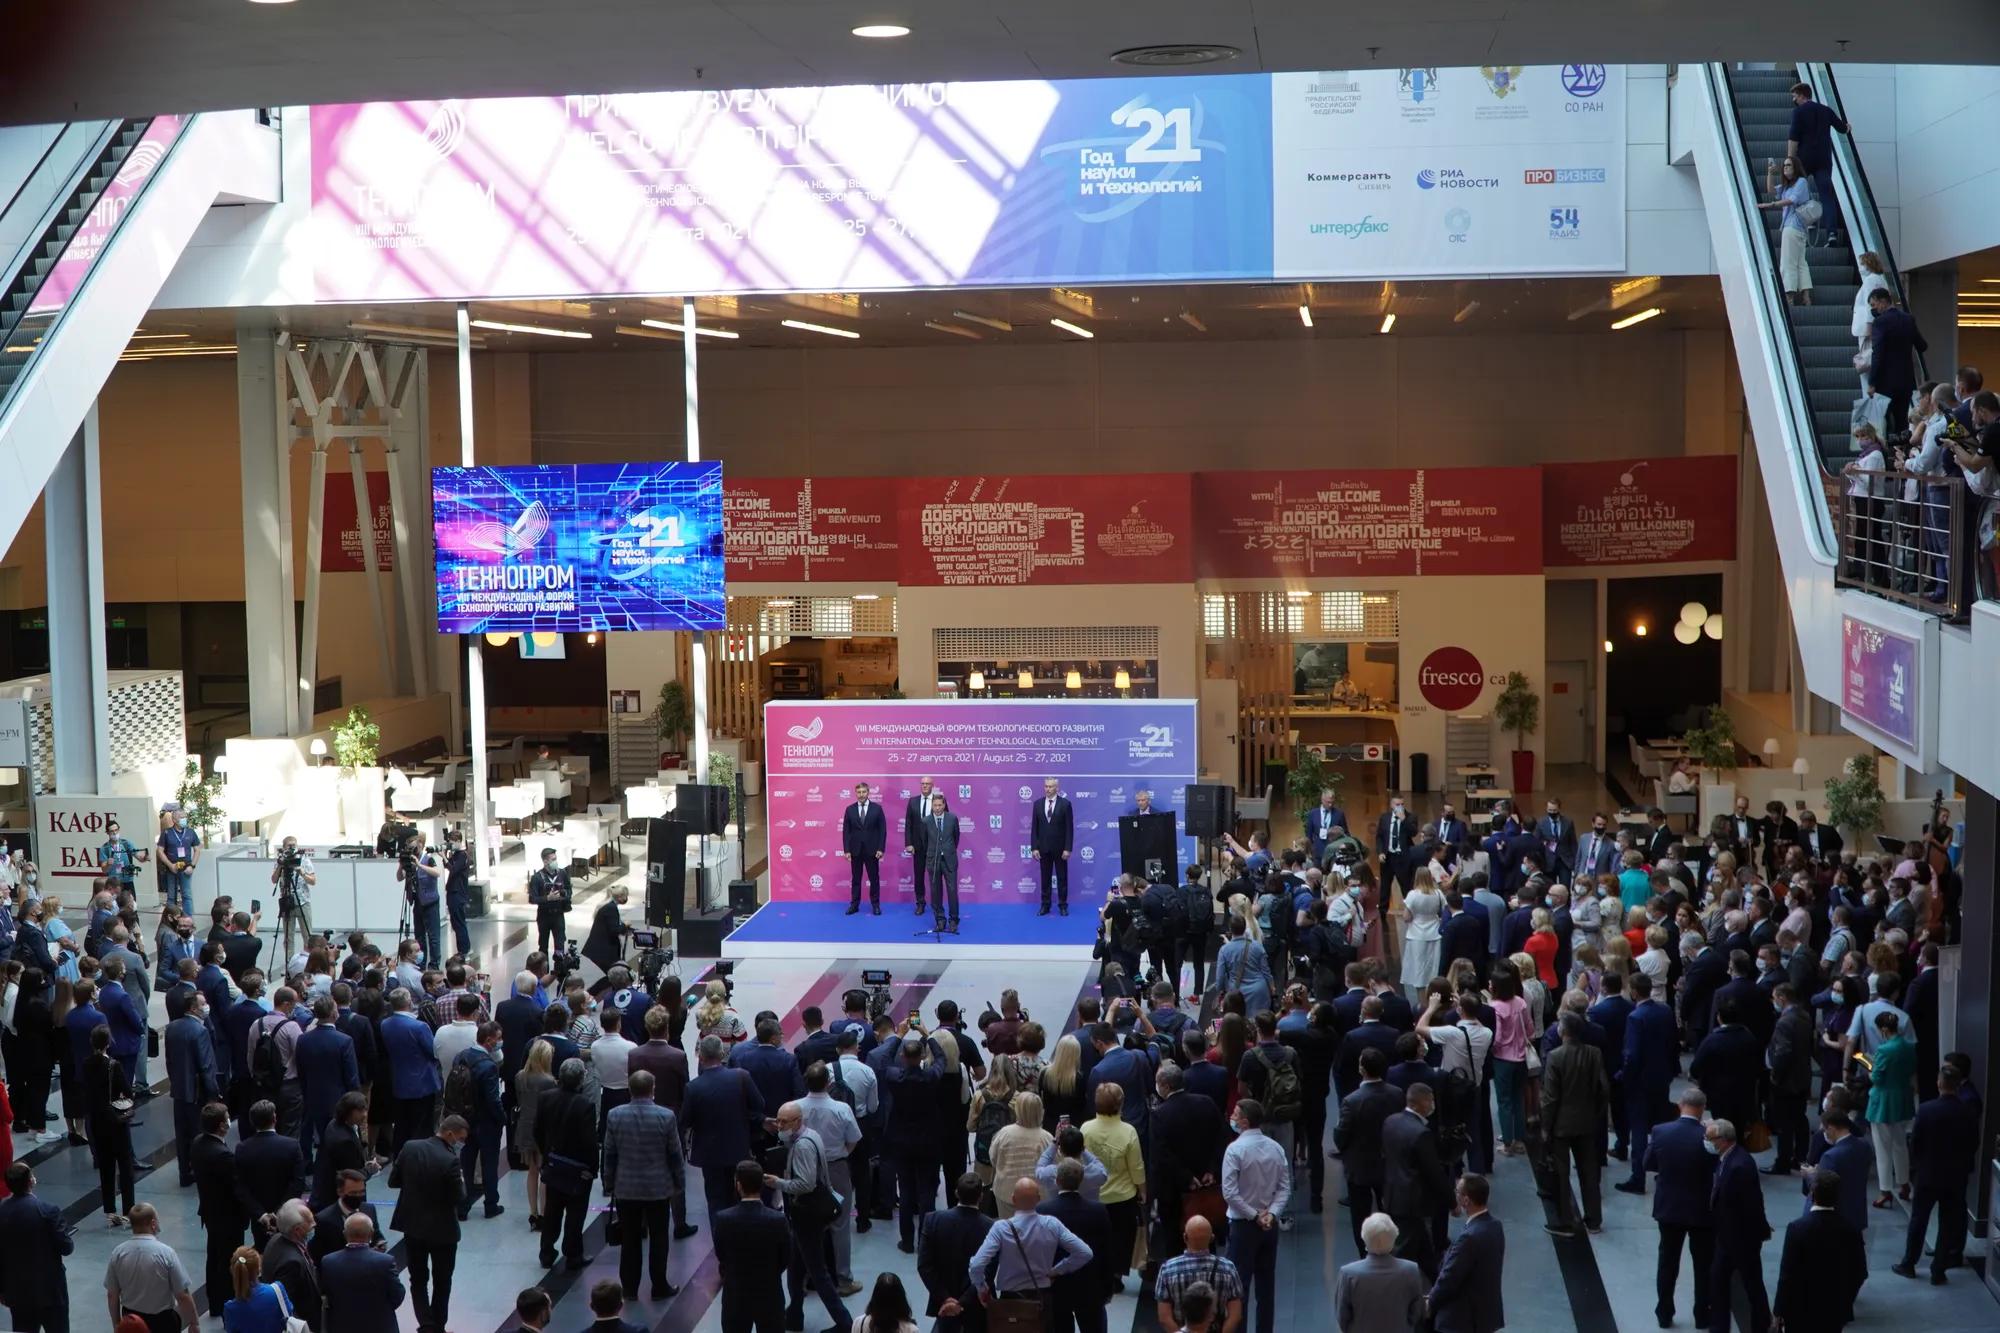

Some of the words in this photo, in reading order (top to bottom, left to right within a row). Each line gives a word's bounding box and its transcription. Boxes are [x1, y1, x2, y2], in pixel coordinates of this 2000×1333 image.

[1564, 102, 1580, 113] СО
[1582, 101, 1604, 112] РАН
[1080, 149, 1115, 166] Год
[1080, 166, 1136, 182] науки
[1307, 172, 1391, 182] Коммерсантъ
[1440, 169, 1464, 178] РИА
[1080, 183, 1093, 195] и
[1096, 176, 1202, 195] технологий
[1440, 178, 1499, 188] НОВОСТИ
[1550, 208, 1580, 229] 54
[1549, 229, 1580, 238] РАДИО
[1316, 490, 1381, 503] WELCOME
[723, 498, 771, 510] ELCOME
[972, 502, 1034, 513] BIENVENUE
[828, 515, 881, 524] BENVENUTO
[921, 509, 973, 522] ДОБРО
[973, 512, 1013, 520] WELCOME
[1282, 510, 1340, 525] ДОБРО
[921, 521, 1028, 535] ПОЖАЛОВАТЬ
[1311, 523, 1431, 540] ПОЖАЛОВАТЬ
[1561, 523, 1617, 534] HERZLICH
[1620, 519, 1695, 532] WILLKOMMEN
[341, 530, 391, 540] HERICH
[723, 530, 819, 545] ЖАЛОВАТЬ
[1071, 512, 1085, 557] WITAJ
[612, 538, 633, 550] Год
[1243, 534, 1305, 550] ようこそ
[1377, 538, 1442, 549] BIENVENUE
[612, 549, 646, 558] науки
[767, 545, 829, 556] BIENVENUE
[456, 564, 574, 590] ТЕХНОПРОМ
[456, 593, 470, 602] VIII
[471, 591, 544, 602] МЕЖДУНАРОДНЫЙ
[546, 591, 574, 601] ФОРУМ
[456, 602, 534, 613] ТЕХНОЛОГИЧЕСКОГО
[535, 602, 575, 612] РАЗВИТИЯ
[1421, 666, 1482, 686] fresco
[1489, 673, 1513, 686] ca
[854, 724, 867, 732] VIII
[868, 723, 945, 733] МЕЖДУНАРОДНЫЙ
[946, 724, 976, 733] ФОРУМ
[978, 724, 1060, 733] ТЕХНОЛОГИЧЕСКОГО
[1061, 724, 1105, 733] РАЗВИТИЯ
[860, 737, 873, 745] VIII
[874, 737, 934, 745] INTERNATIONAL
[935, 737, 963, 745] FORUM
[965, 737, 975, 745] OF
[977, 737, 1040, 746] TECHNOLOGICAL
[1041, 737, 1099, 746] DEVELOPMENT
[782, 744, 834, 757] ТЕХНОПРОМ
[887, 752, 899, 762] 25
[906, 752, 918, 762] 27
[919, 754, 953, 764] августа
[954, 752, 975, 762] 2021
[983, 753, 1014, 764] August
[1015, 753, 1027, 762] 25
[1034, 753, 1049, 763] 27,
[1050, 753, 1071, 762] 2021
[61, 846, 101, 868] БА
